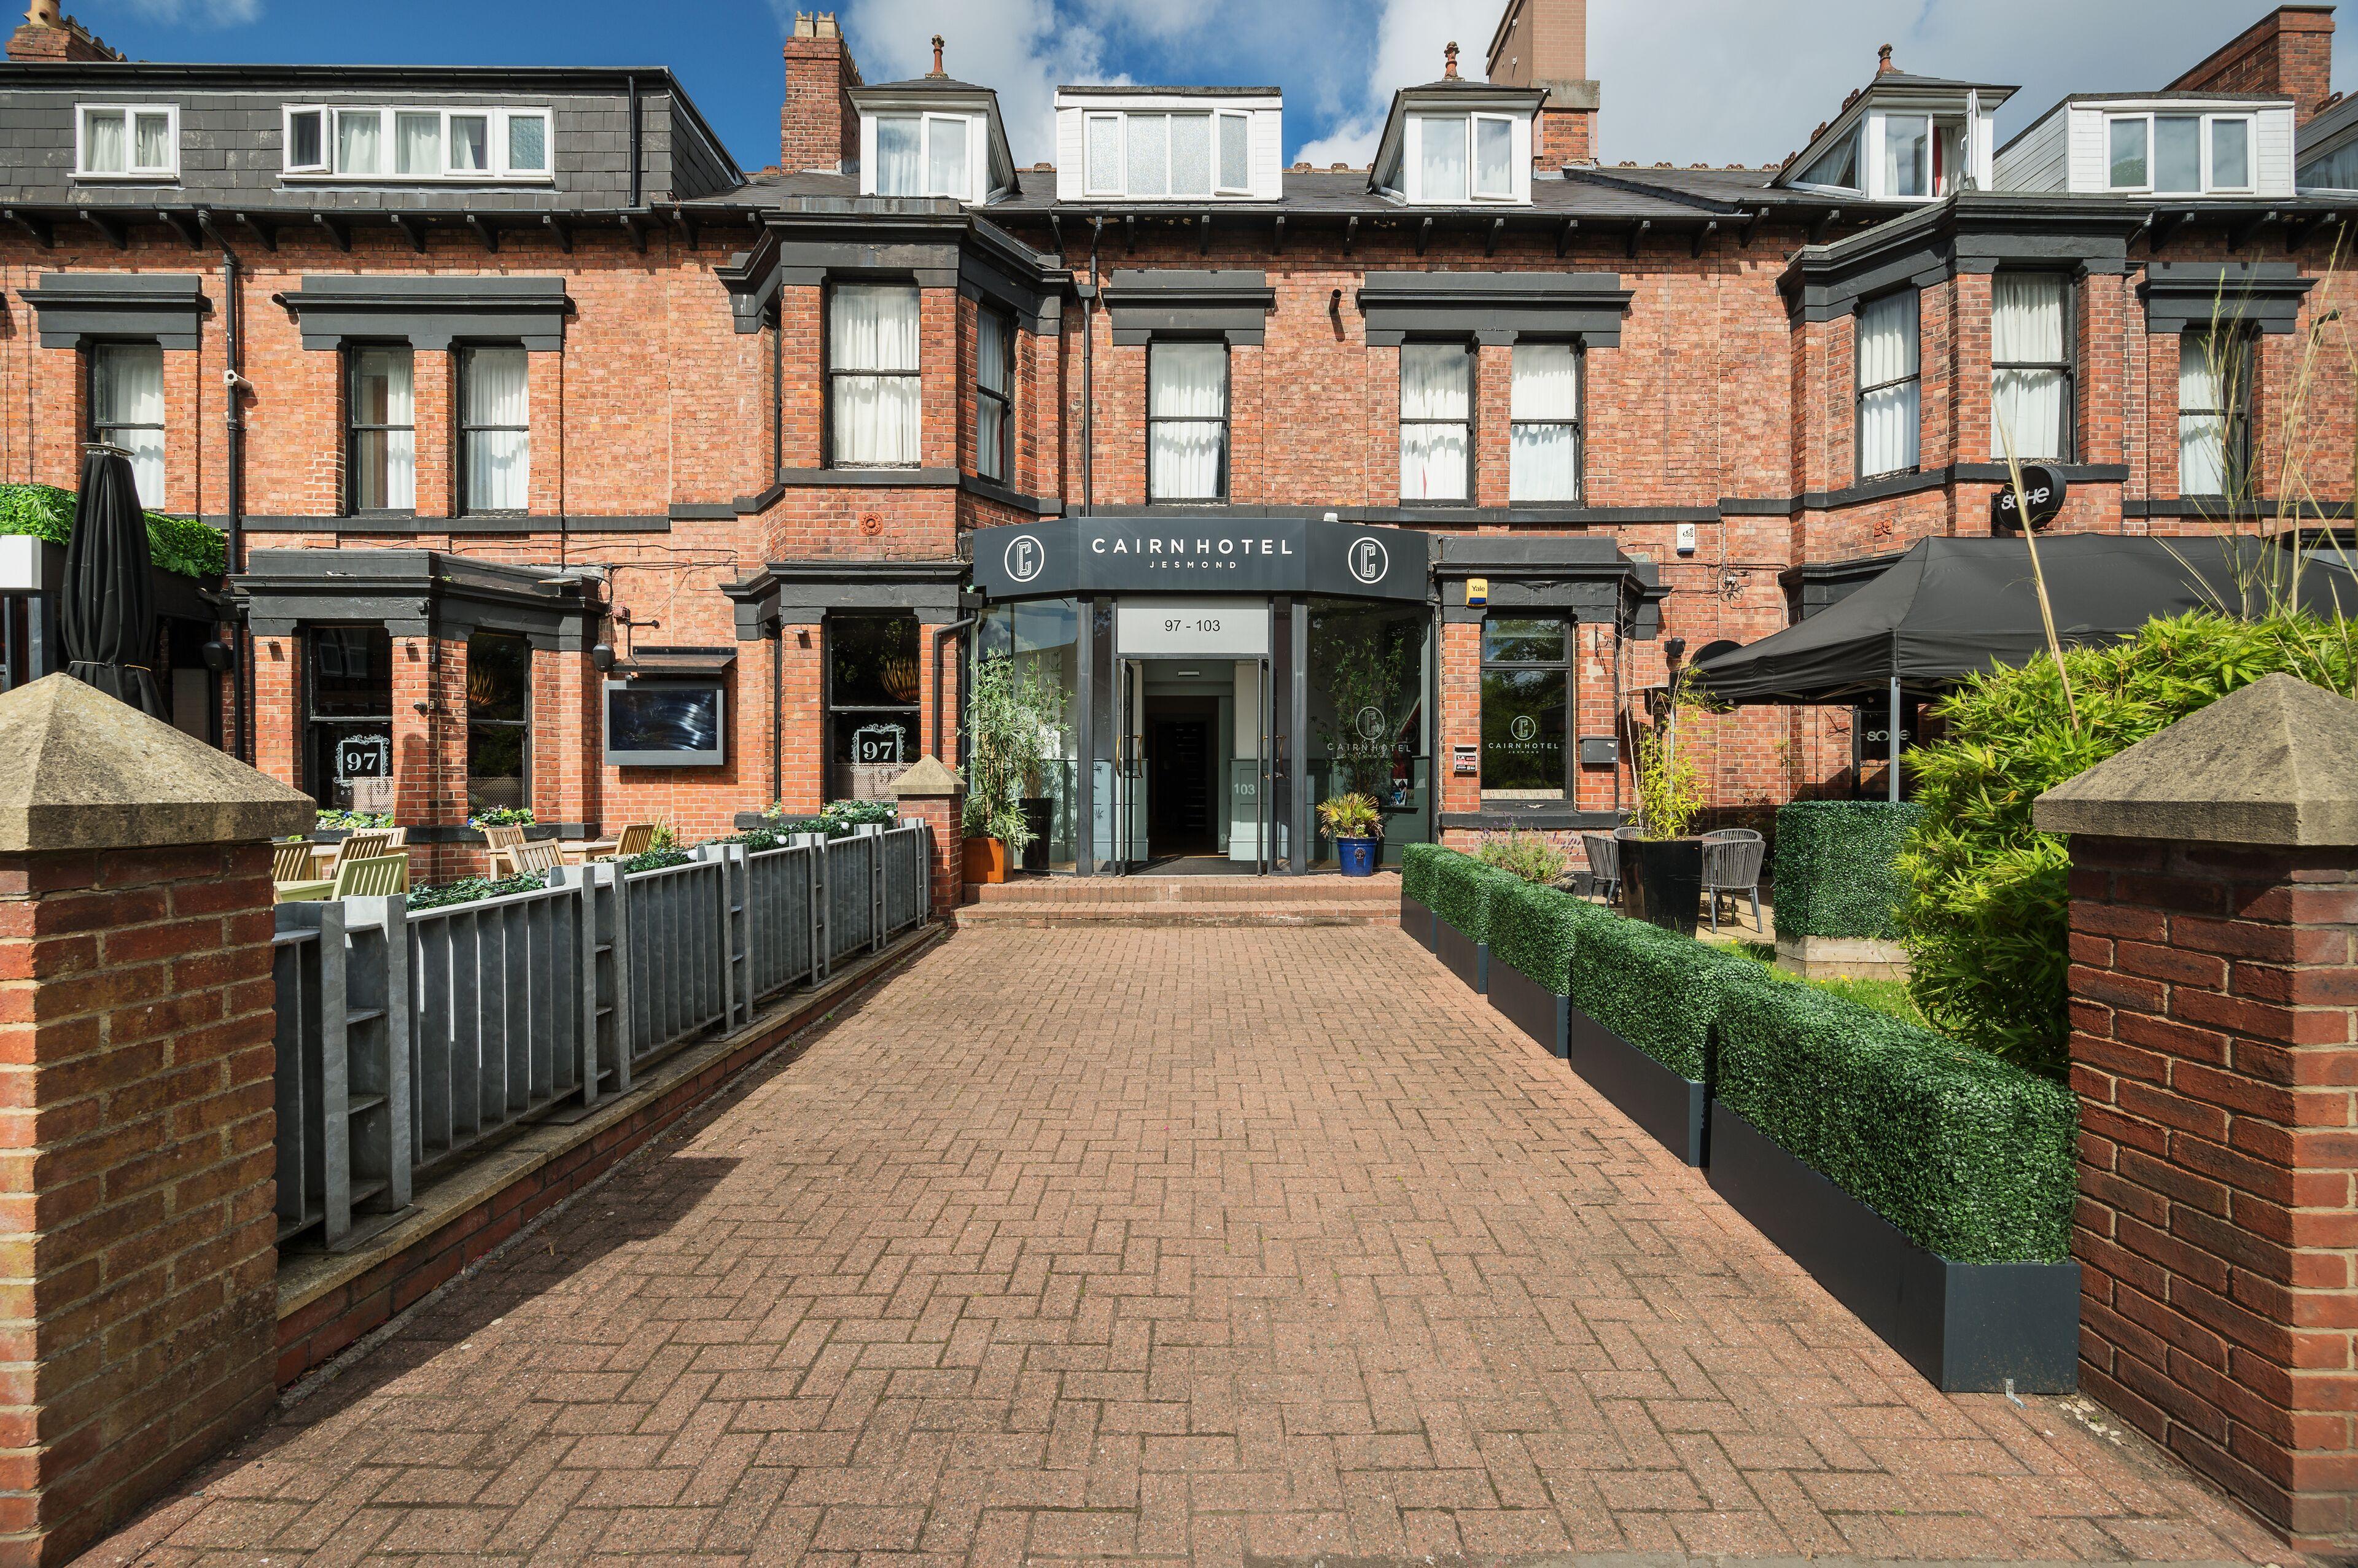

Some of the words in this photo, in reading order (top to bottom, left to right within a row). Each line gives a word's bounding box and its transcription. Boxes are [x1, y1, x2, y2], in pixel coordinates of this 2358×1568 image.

[1092, 538, 1184, 554] CAIRN
[1197, 539, 1293, 554] HOTEL
[1150, 561, 1236, 569] JESMOND
[1165, 619, 1181, 632] 97
[1196, 619, 1220, 632] 103
[863, 742, 894, 759] 97
[1327, 743, 1368, 751] CAIRN
[346, 753, 378, 770] 97
[1234, 783, 1255, 795] 103
